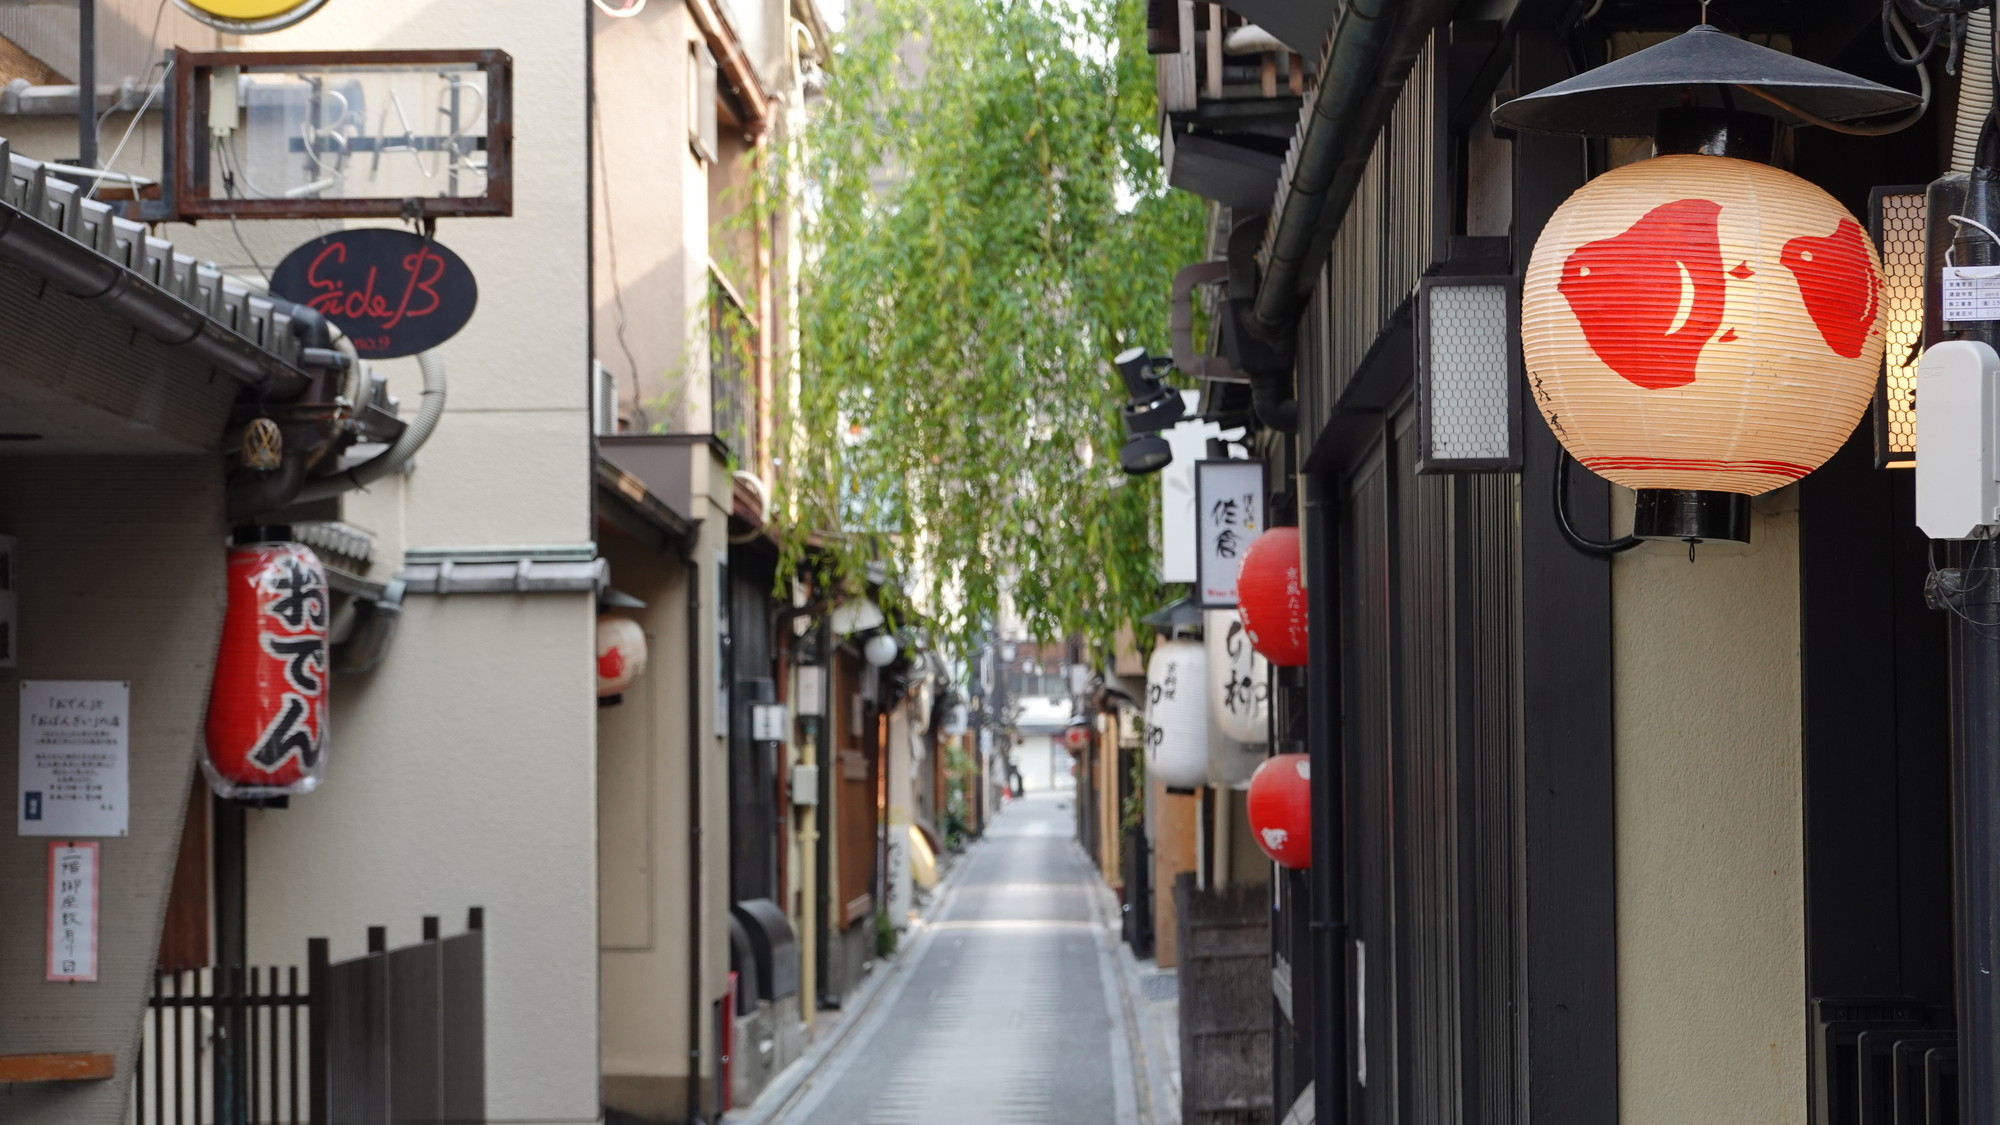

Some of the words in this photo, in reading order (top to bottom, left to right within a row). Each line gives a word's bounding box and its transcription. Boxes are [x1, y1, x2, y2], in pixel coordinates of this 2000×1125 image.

[307, 242, 394, 319] Side
[381, 246, 445, 330] B
[251, 556, 329, 773] おでん
